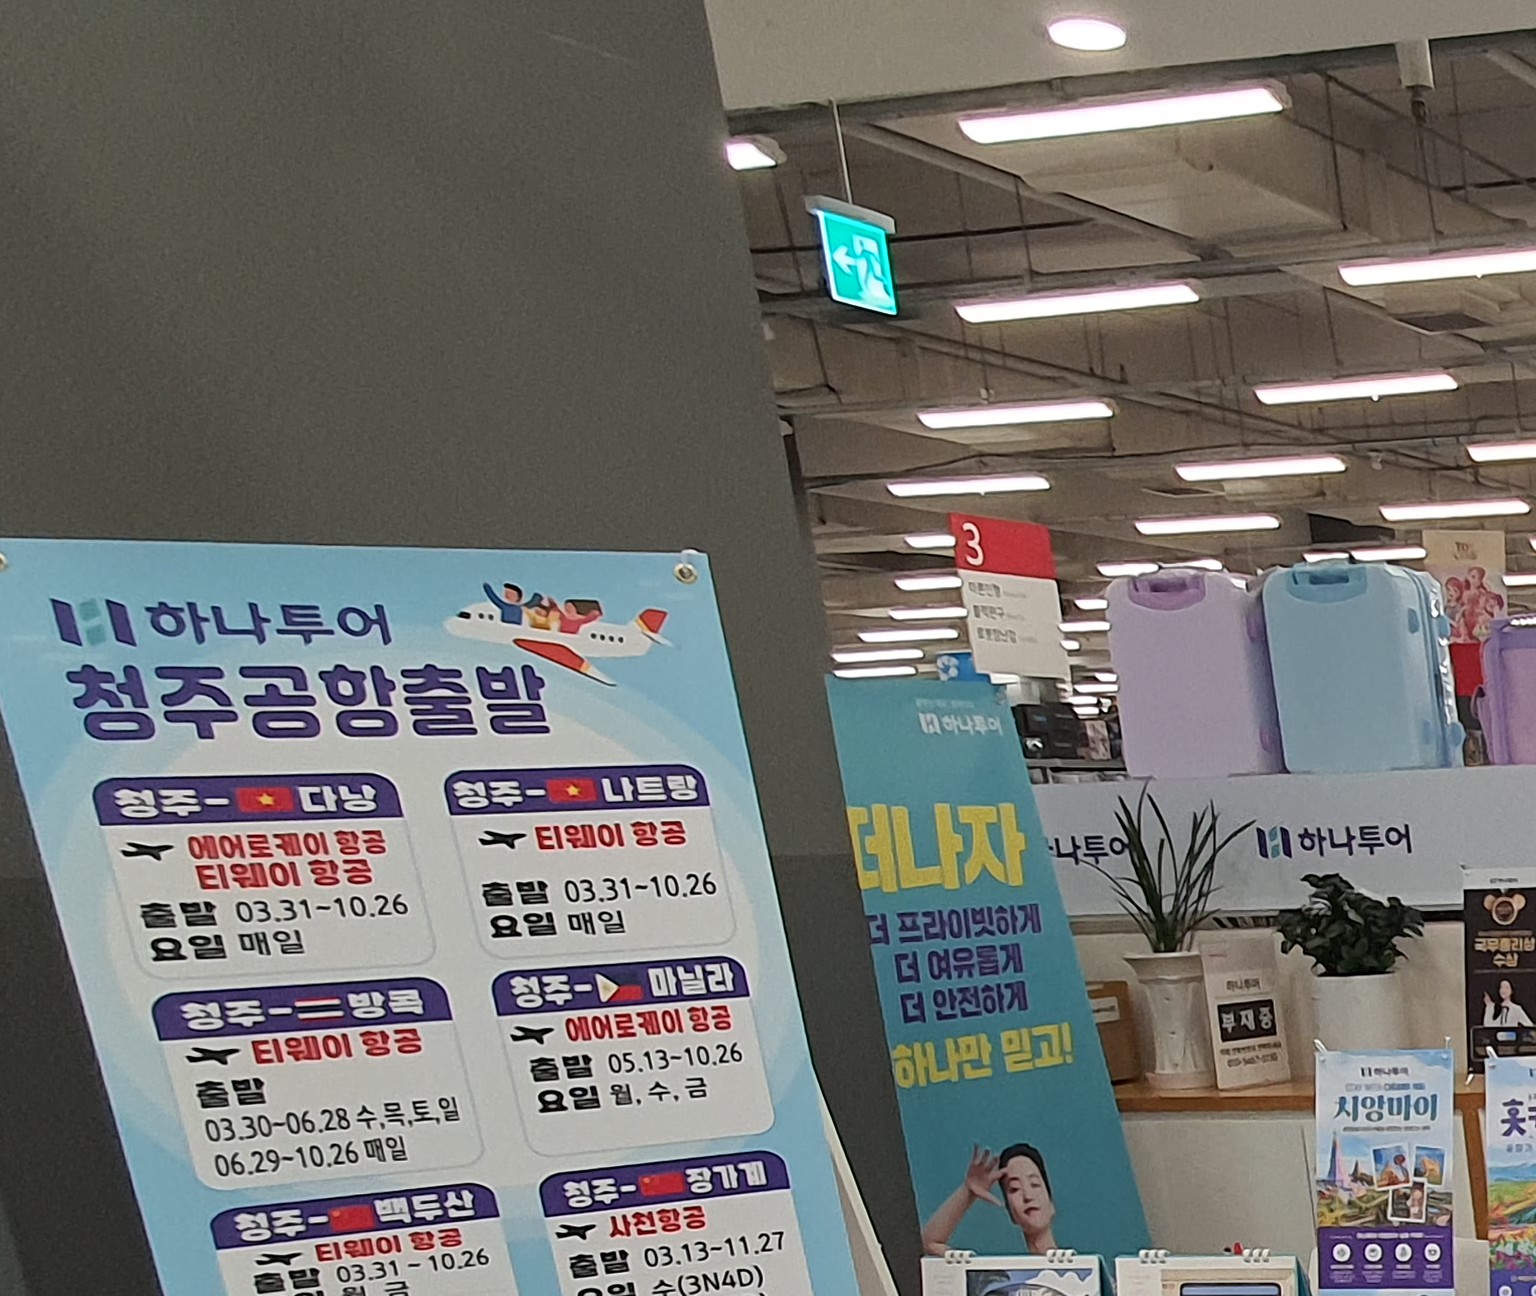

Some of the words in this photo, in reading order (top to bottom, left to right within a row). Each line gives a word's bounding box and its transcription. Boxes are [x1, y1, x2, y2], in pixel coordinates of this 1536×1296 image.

[962, 522, 984, 566] 3
[145, 597, 391, 647] 하나투어
[66, 663, 552, 740] 청주공항출발
[942, 715, 1003, 736] 하나투어
[298, 784, 377, 813] 다낭
[602, 774, 698, 802] 나트랑
[186, 829, 329, 860] 에어로케이
[334, 827, 387, 855] 항공
[534, 822, 626, 851] 티웨이
[632, 820, 687, 847] 항공
[1048, 834, 1130, 865] 나투어
[1298, 823, 1413, 857] 하나투어
[195, 862, 300, 890] 티웨이
[309, 859, 374, 886] 항공
[480, 879, 548, 908] 출발
[564, 872, 718, 904] 03.31~10.26
[139, 899, 218, 928] 출발
[234, 892, 409, 926] 03.31~10.26
[490, 910, 557, 938] 요일
[567, 908, 627, 936] 매일
[868, 913, 891, 945] 더
[897, 902, 1041, 942] 프라이빗하게
[150, 933, 226, 962] 요일
[238, 928, 306, 957] 매일
[1474, 937, 1536, 952] 국무총리상
[895, 951, 921, 984] 더
[927, 943, 1025, 980] 여유롭게
[648, 964, 736, 999] 마닐라
[347, 994, 425, 1022] 방콕
[900, 992, 926, 1024] 더
[933, 981, 1029, 1021] 안전하게
[1221, 1007, 1273, 1034] 부재중
[251, 1031, 353, 1065] 티웨이
[361, 1027, 423, 1057] 항공
[529, 1053, 593, 1082] 출발
[607, 1044, 745, 1076] 05.13~10.26
[893, 1037, 994, 1089] 하나만
[1000, 1022, 1074, 1073] 믿고!
[195, 1077, 266, 1108] 출발
[1334, 1093, 1438, 1122] 치앙마이
[204, 1106, 351, 1143] 03.30~06.28
[214, 1142, 359, 1178] 06.29~10.26
[364, 1136, 408, 1165] 매일
[686, 1160, 769, 1193] 장가계
[375, 1190, 476, 1225] 백두산
[609, 1205, 707, 1238] 사천항공
[568, 1248, 631, 1279] 출발
[644, 1231, 786, 1268] 03.13~11.27
